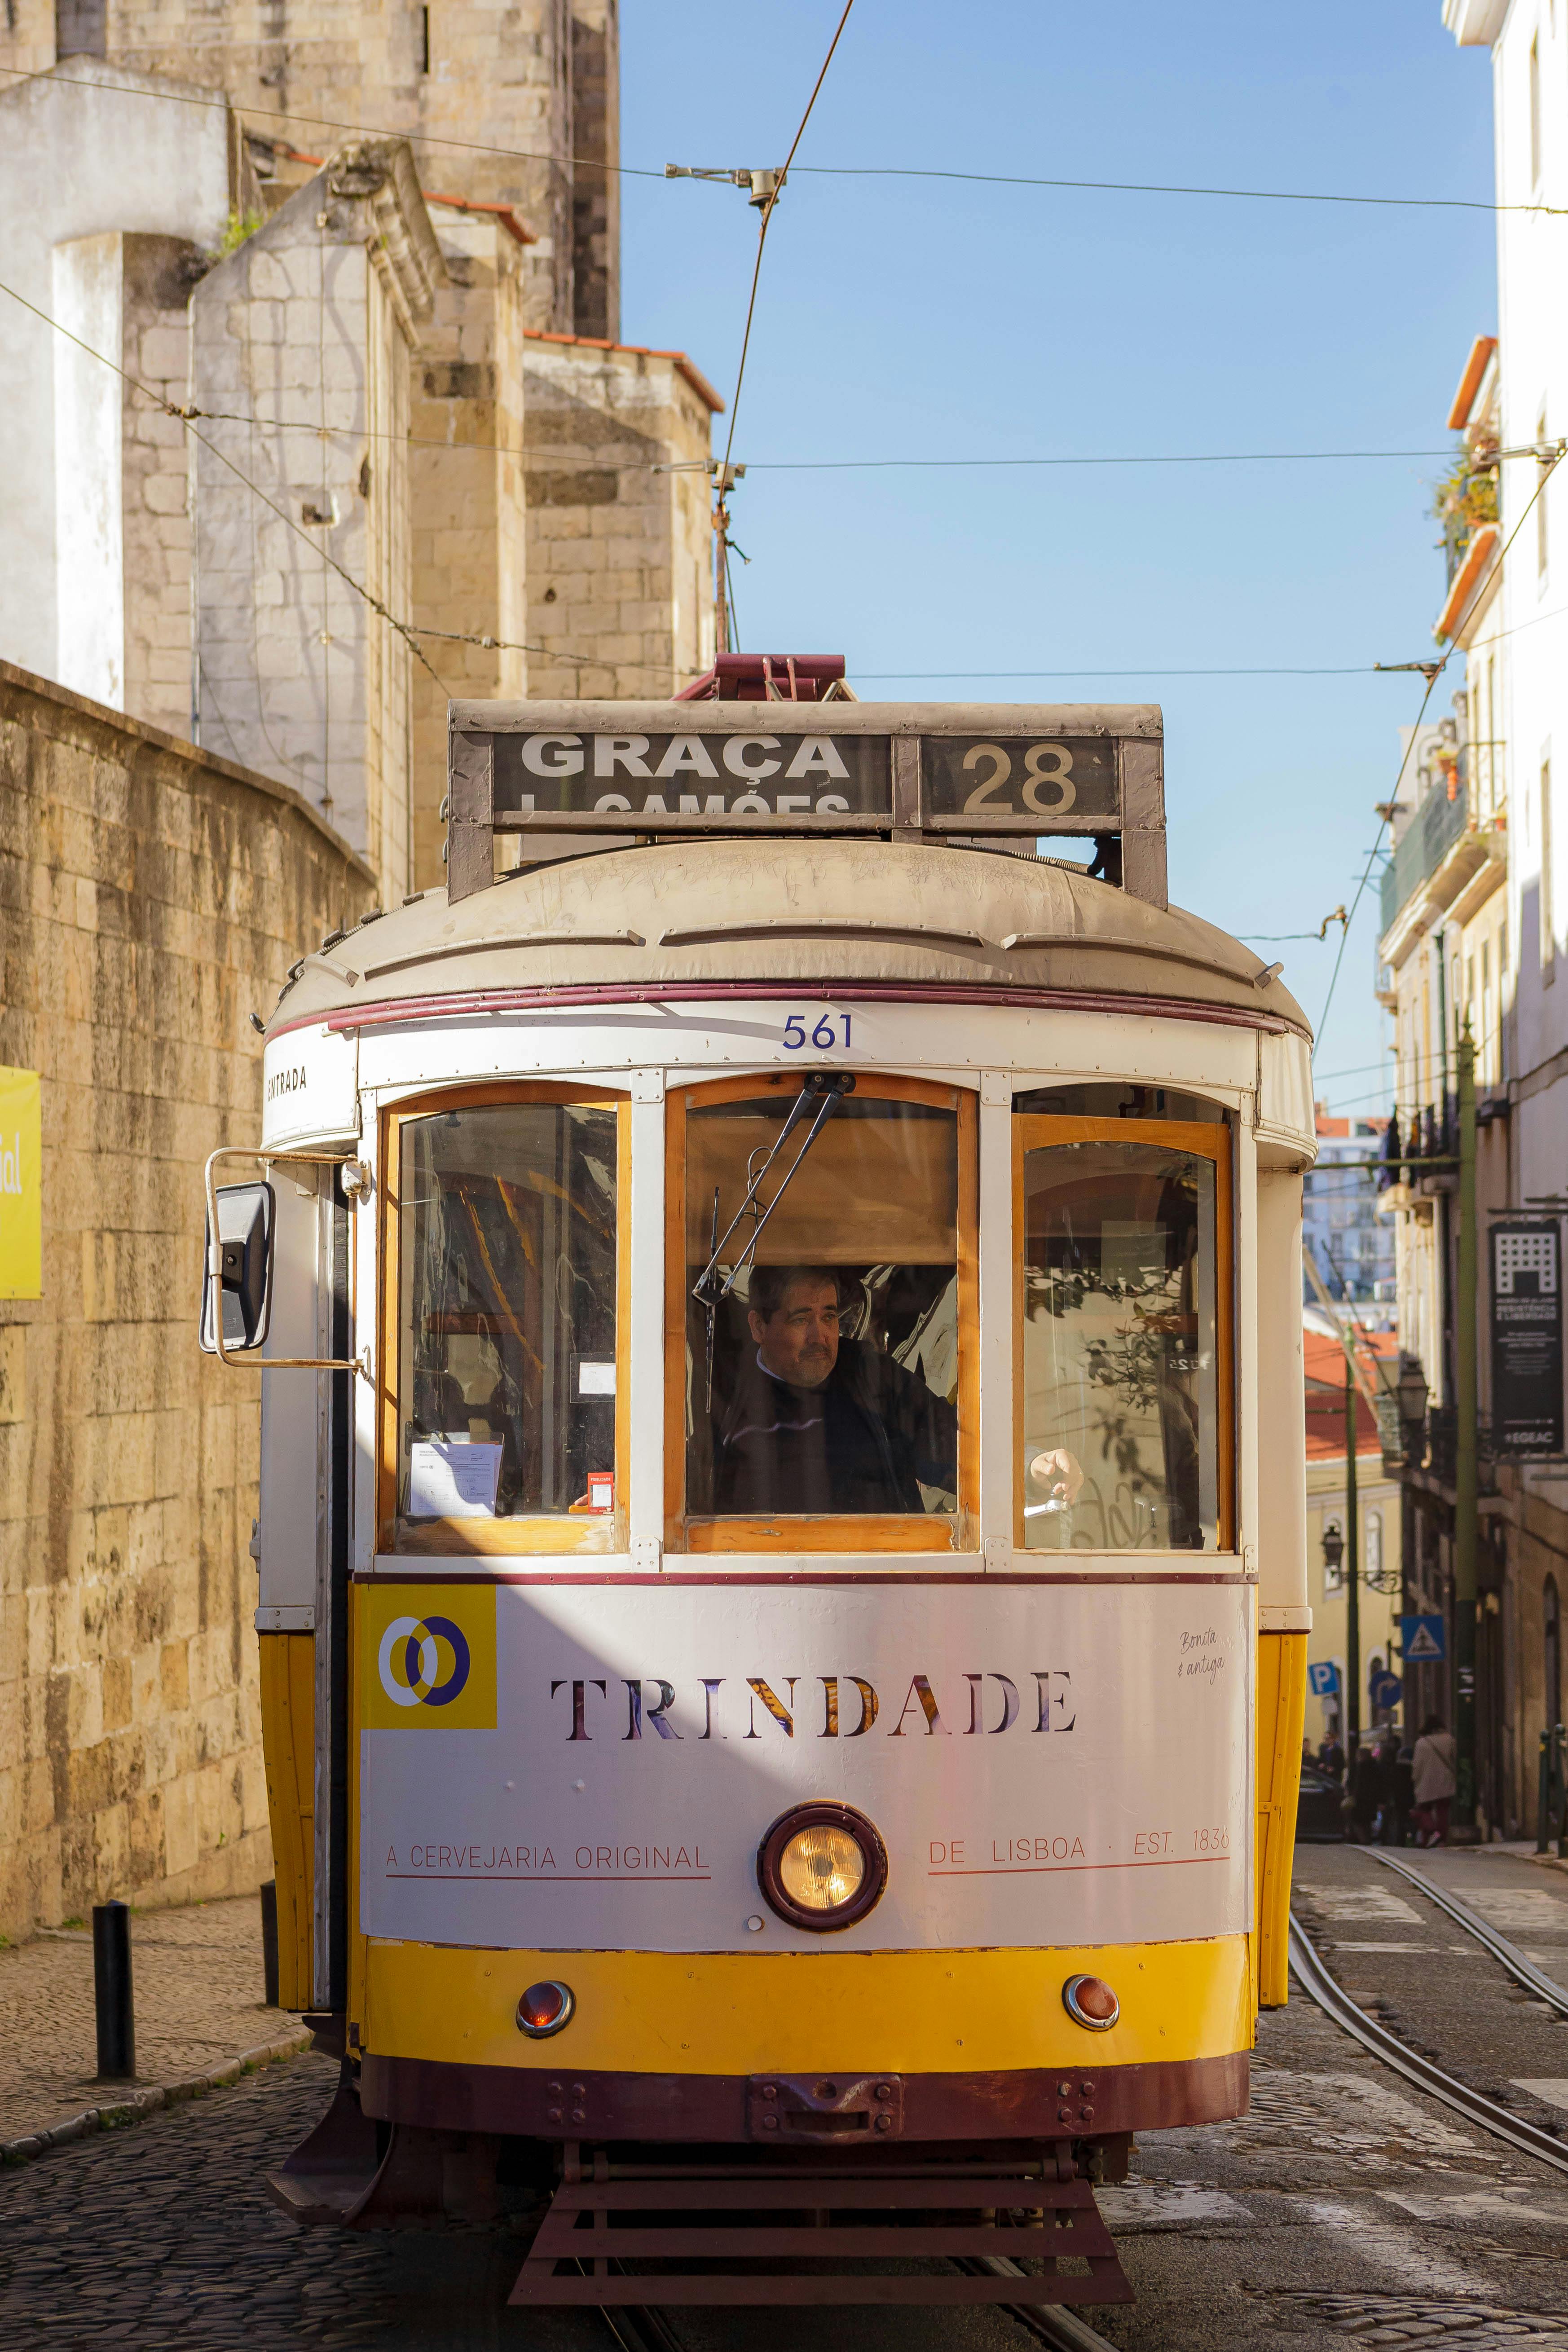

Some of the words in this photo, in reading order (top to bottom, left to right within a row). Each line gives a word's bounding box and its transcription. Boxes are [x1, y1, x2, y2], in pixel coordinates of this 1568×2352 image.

[521, 734, 850, 785] GRAÇA
[962, 743, 1076, 815] 28
[782, 1013, 851, 1050] 561
[268, 1066, 307, 1102] ENTRADA
[1180, 1627, 1218, 1655] Bonita
[1187, 1655, 1225, 1685] antiga
[1314, 1665, 1331, 1692] P
[551, 1671, 1076, 1741] TRINDADE
[386, 1845, 398, 1867] A
[410, 1845, 557, 1869] CERVEJARIA
[575, 1846, 710, 1869] ORIGINAL
[929, 1841, 965, 1864] DE
[992, 1837, 1086, 1862] LISBOA
[1134, 1832, 1173, 1855] EST.
[1193, 1827, 1229, 1850] 1836
